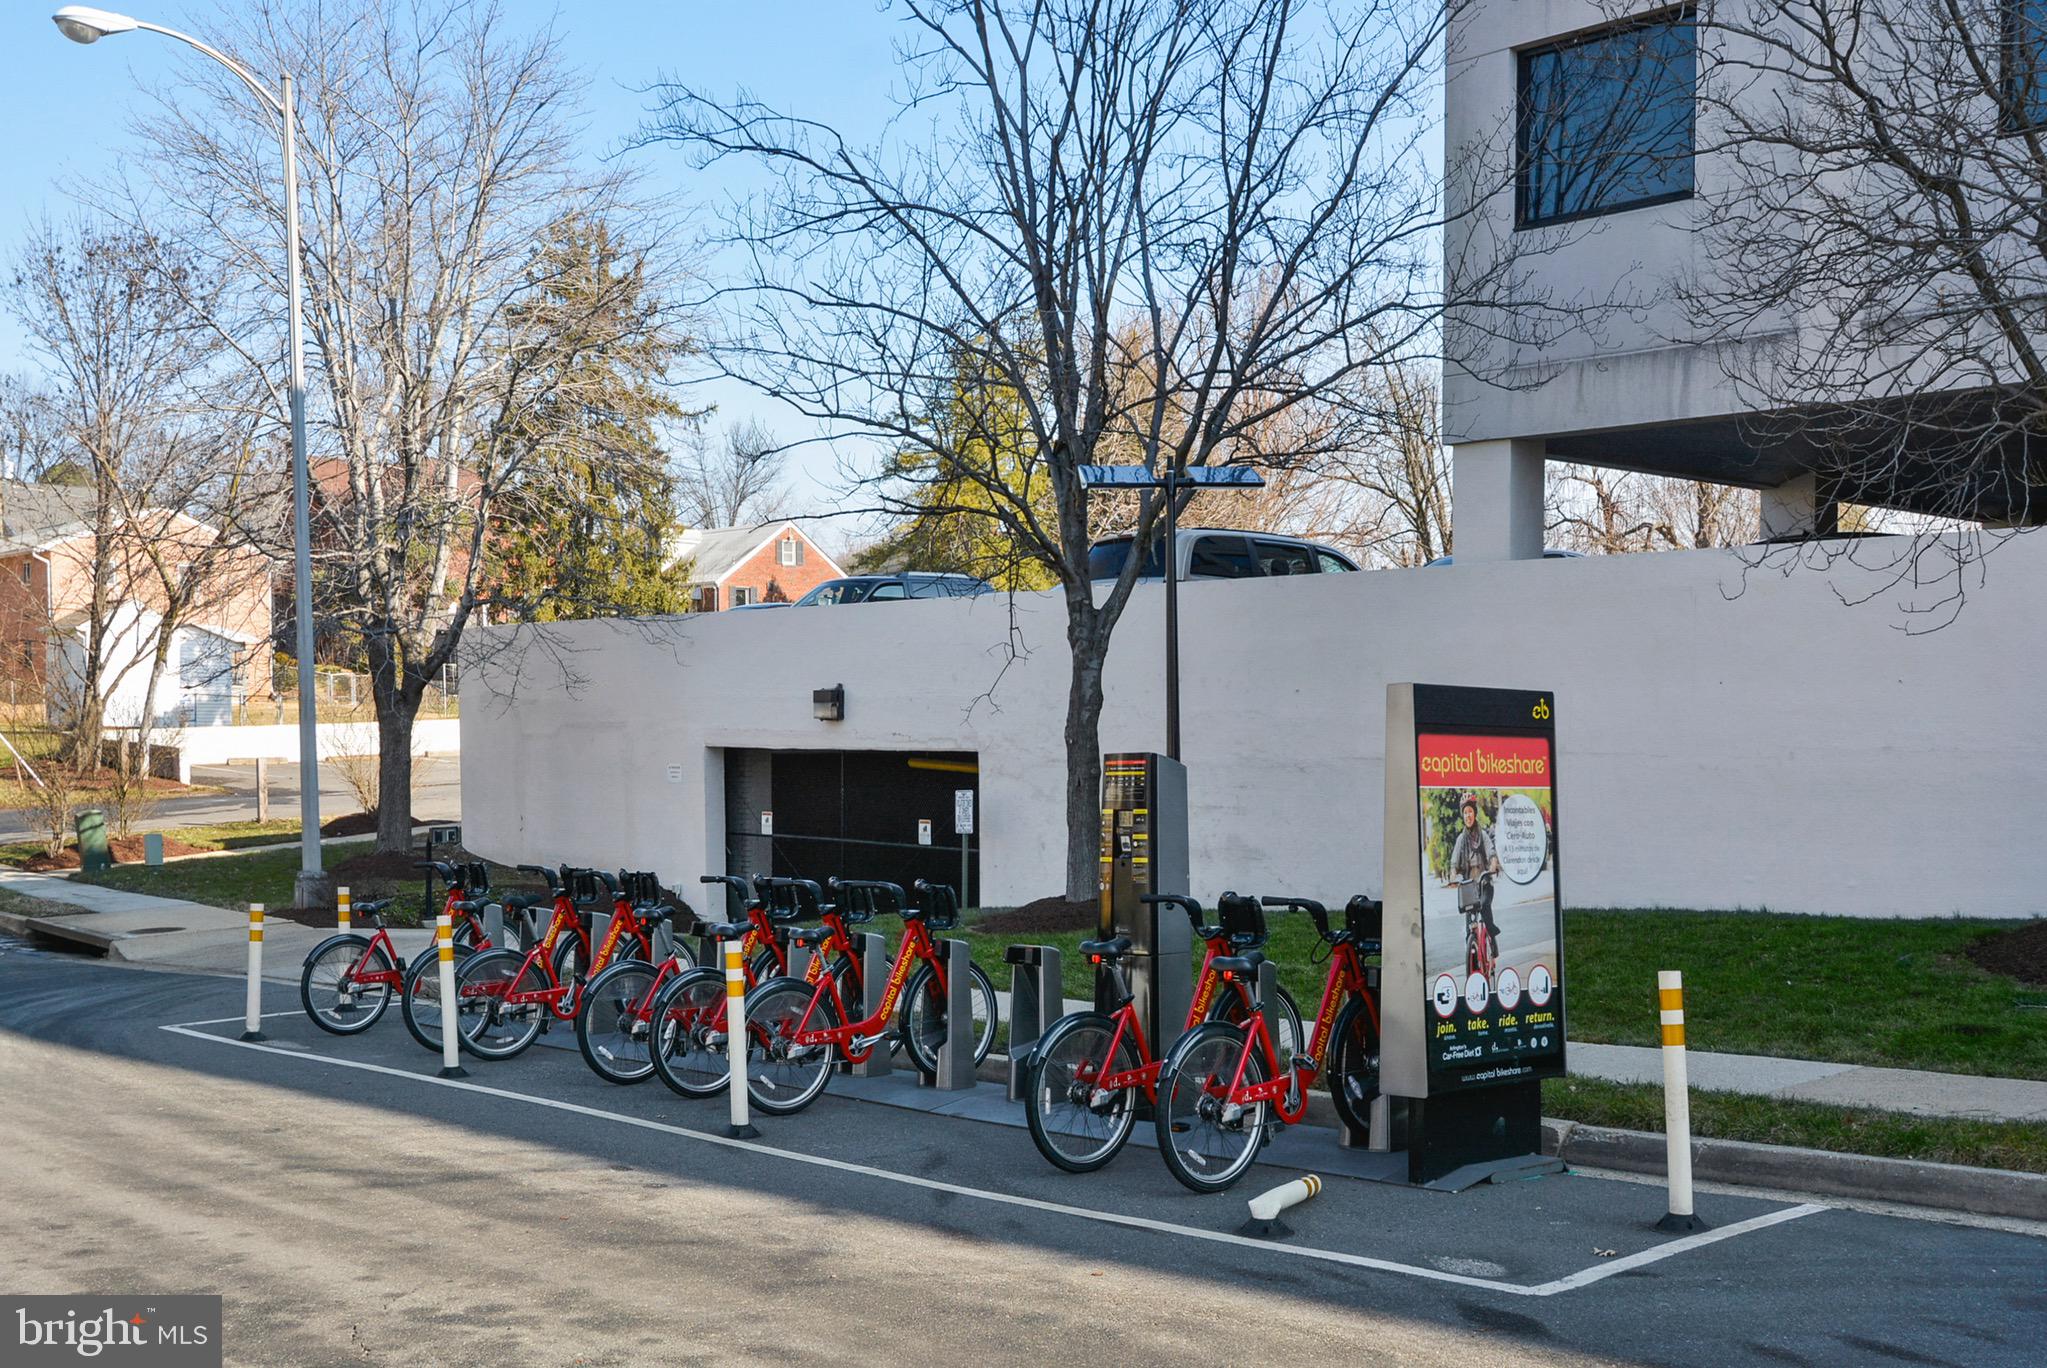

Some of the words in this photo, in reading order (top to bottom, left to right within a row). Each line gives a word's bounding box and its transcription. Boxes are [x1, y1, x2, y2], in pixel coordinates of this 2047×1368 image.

[1421, 751, 1473, 778] capital
[1476, 748, 1545, 774] bikeshare
[880, 986, 898, 1020] capital
[891, 941, 916, 985] bikeshare
[1314, 1026, 1329, 1061] apital
[1322, 970, 1345, 1024] bikeshare
[1436, 1021, 1457, 1038] join.
[1467, 1017, 1489, 1031] take.
[1498, 1013, 1518, 1027] ride.
[1525, 1012, 1554, 1024] return.
